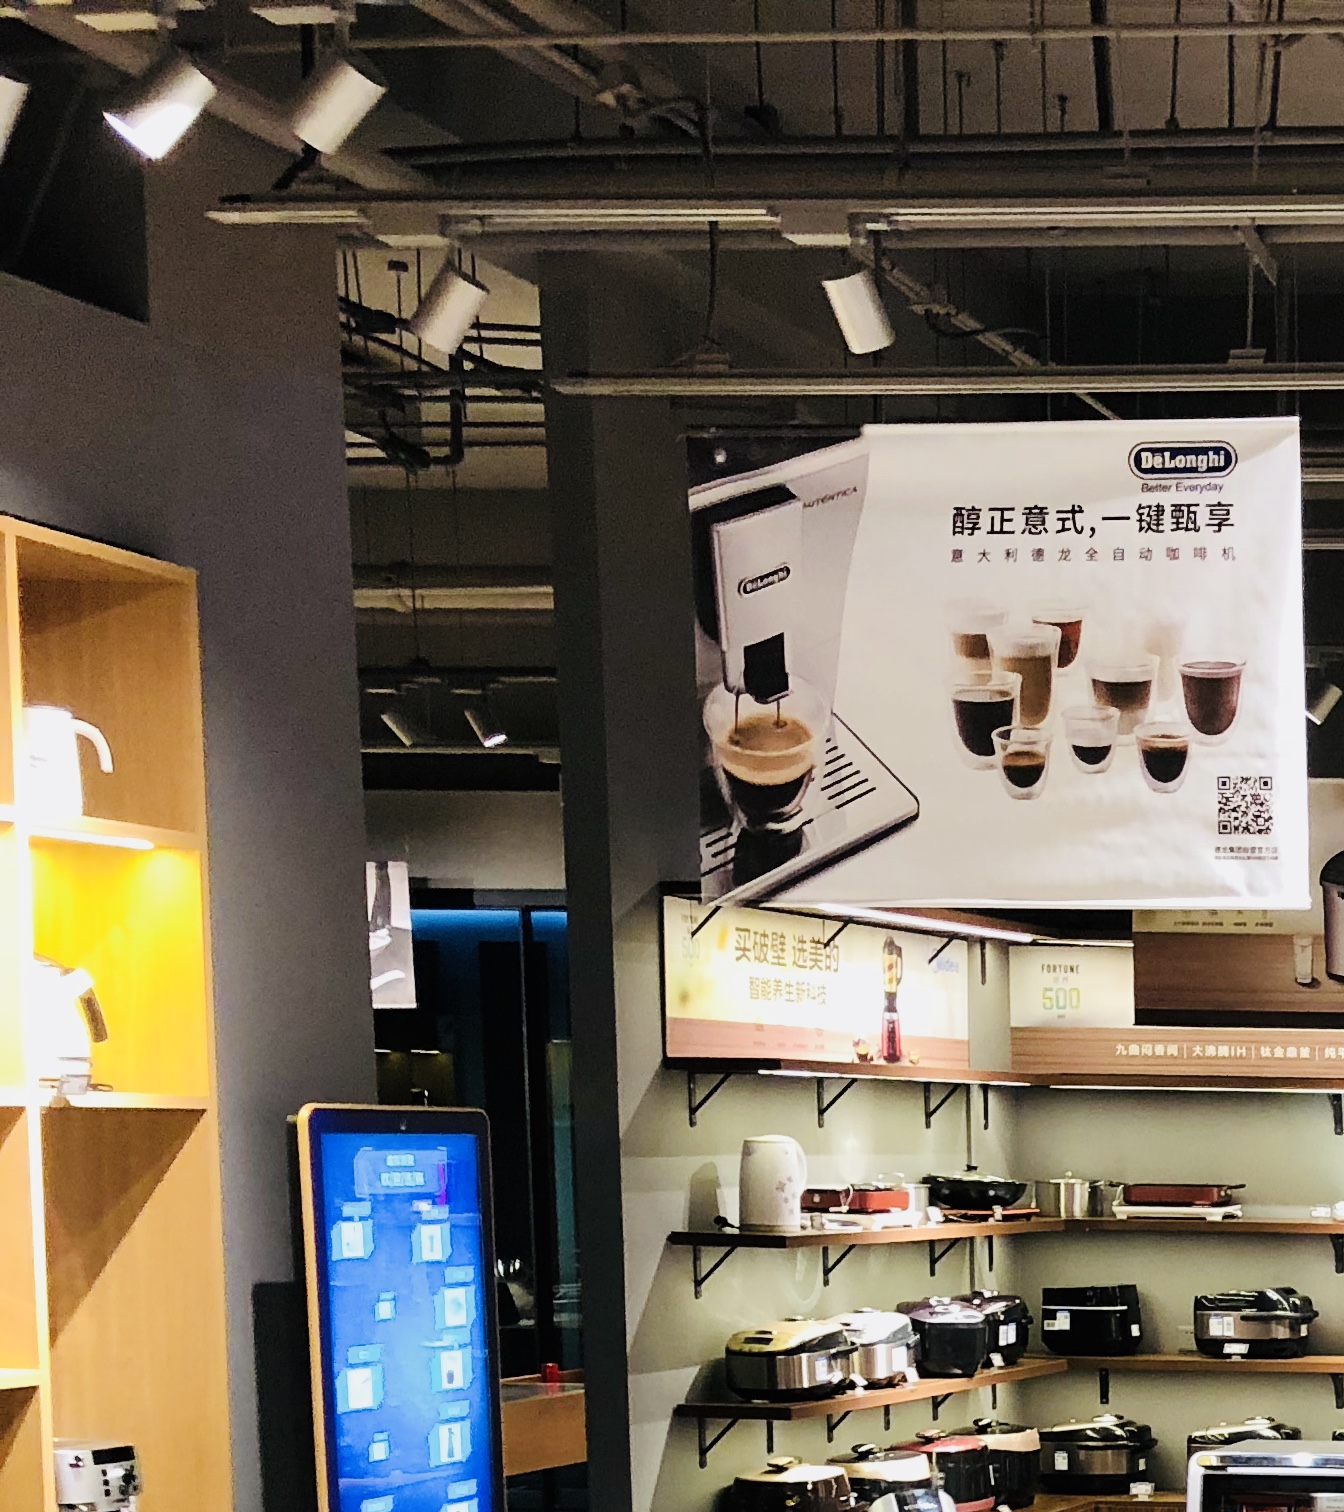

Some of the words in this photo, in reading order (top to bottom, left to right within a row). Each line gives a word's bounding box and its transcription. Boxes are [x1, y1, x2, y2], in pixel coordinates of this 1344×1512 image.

[1141, 482, 1172, 493] Better
[1175, 481, 1224, 494] Everyday
[951, 547, 1236, 563] 意大利德龙全自动咖啡机
[735, 926, 787, 968] 买破壁
[792, 935, 840, 973] 选美的
[1041, 963, 1080, 974] FORTUNE
[1042, 987, 1081, 1010] 500
